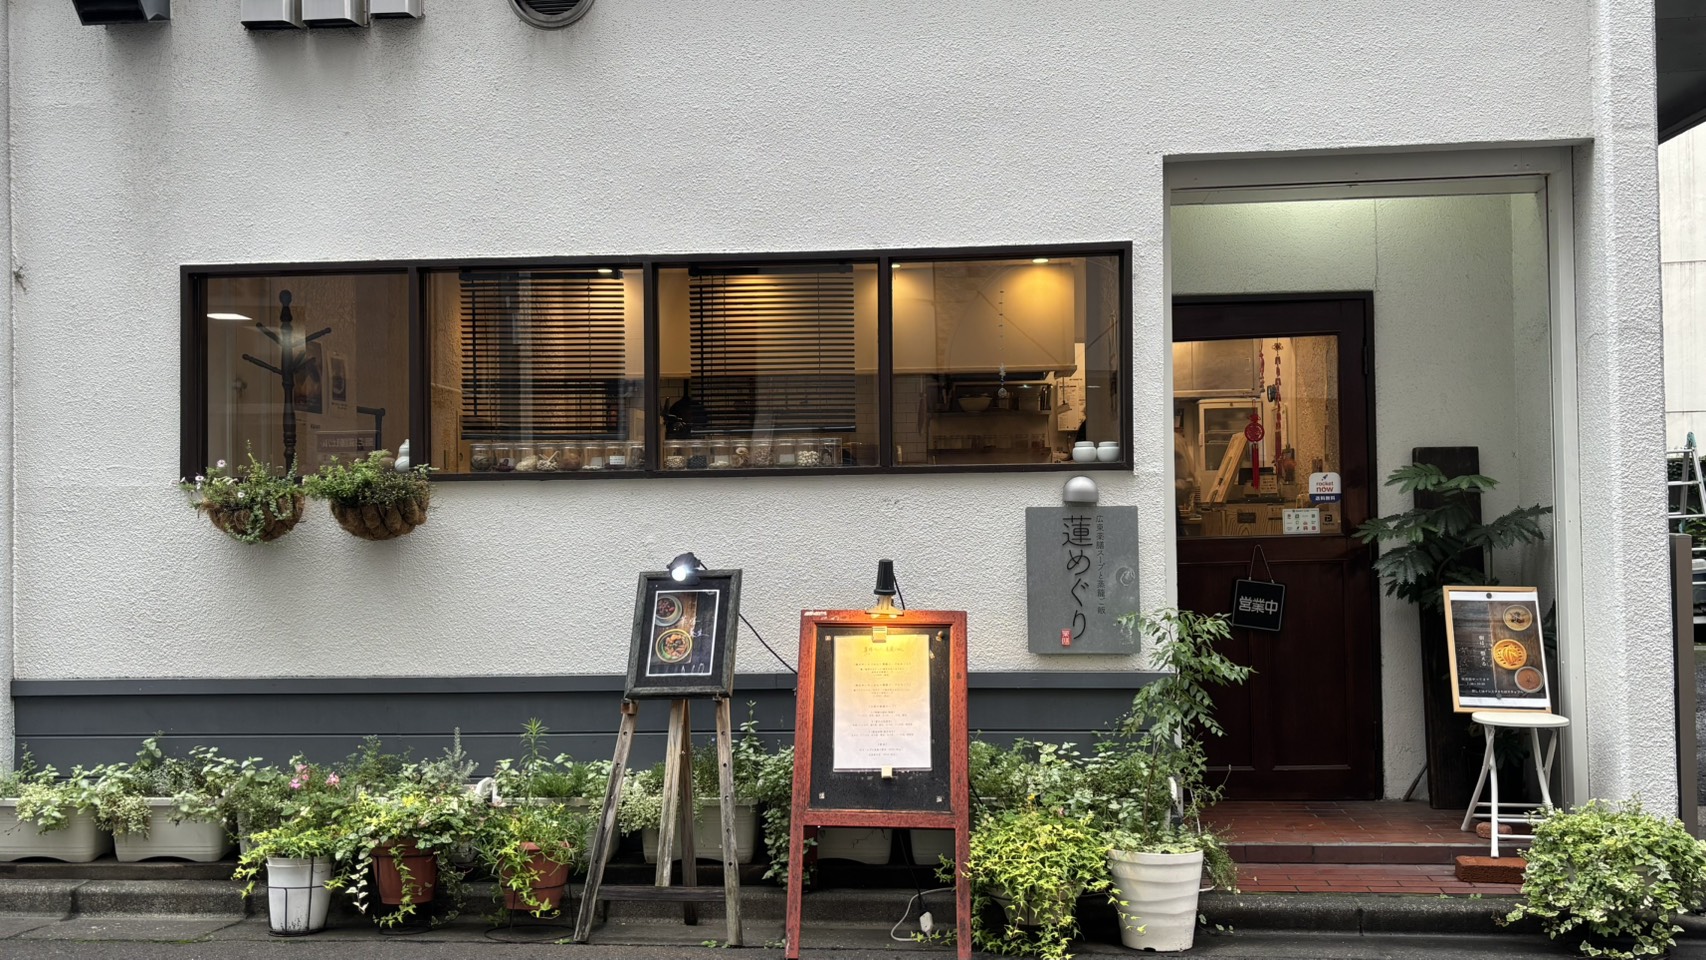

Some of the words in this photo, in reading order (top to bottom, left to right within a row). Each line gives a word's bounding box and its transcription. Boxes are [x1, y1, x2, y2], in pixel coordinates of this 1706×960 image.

[1062, 515, 1093, 639] 蓮めぐり
[1239, 595, 1279, 615] 営業中
